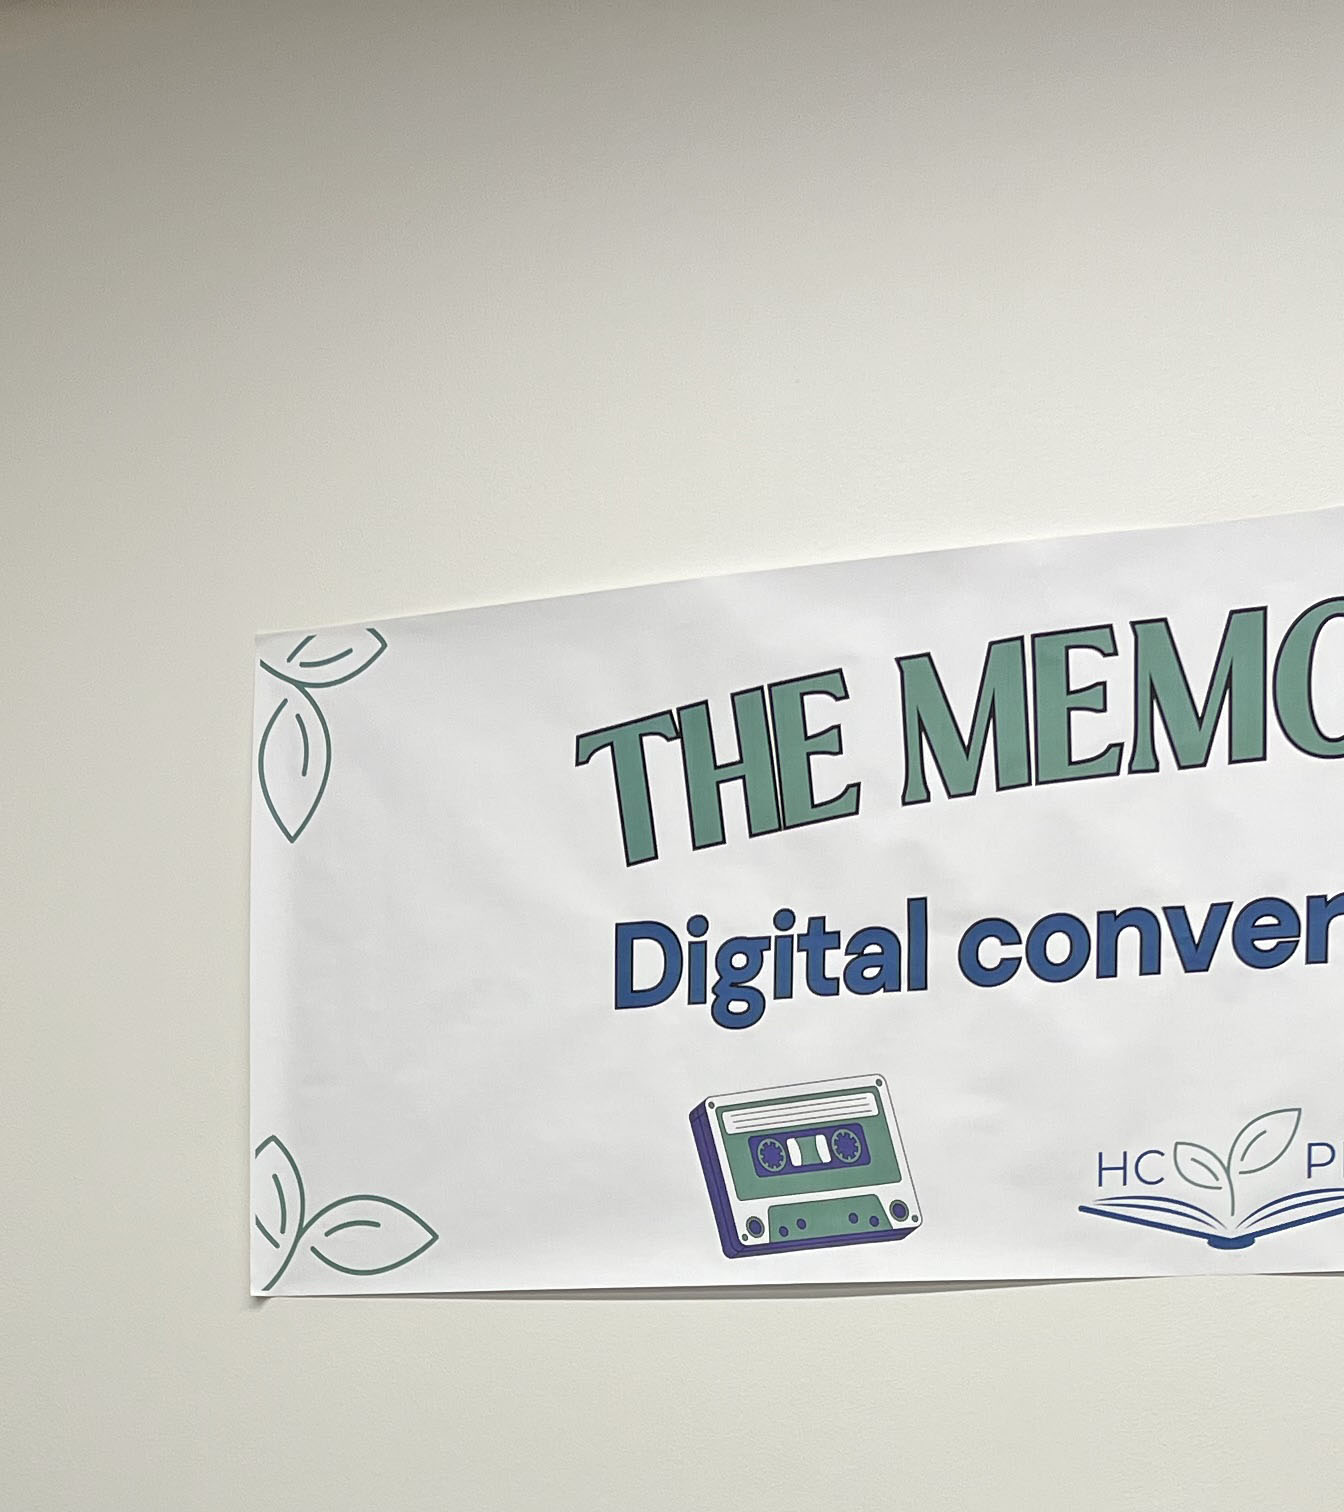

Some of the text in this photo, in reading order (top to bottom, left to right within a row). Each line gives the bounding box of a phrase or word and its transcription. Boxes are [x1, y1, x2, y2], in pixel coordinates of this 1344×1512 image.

[575, 668, 861, 867] THE
[615, 897, 928, 1030] Digital
[1098, 1149, 1165, 1187] HC
